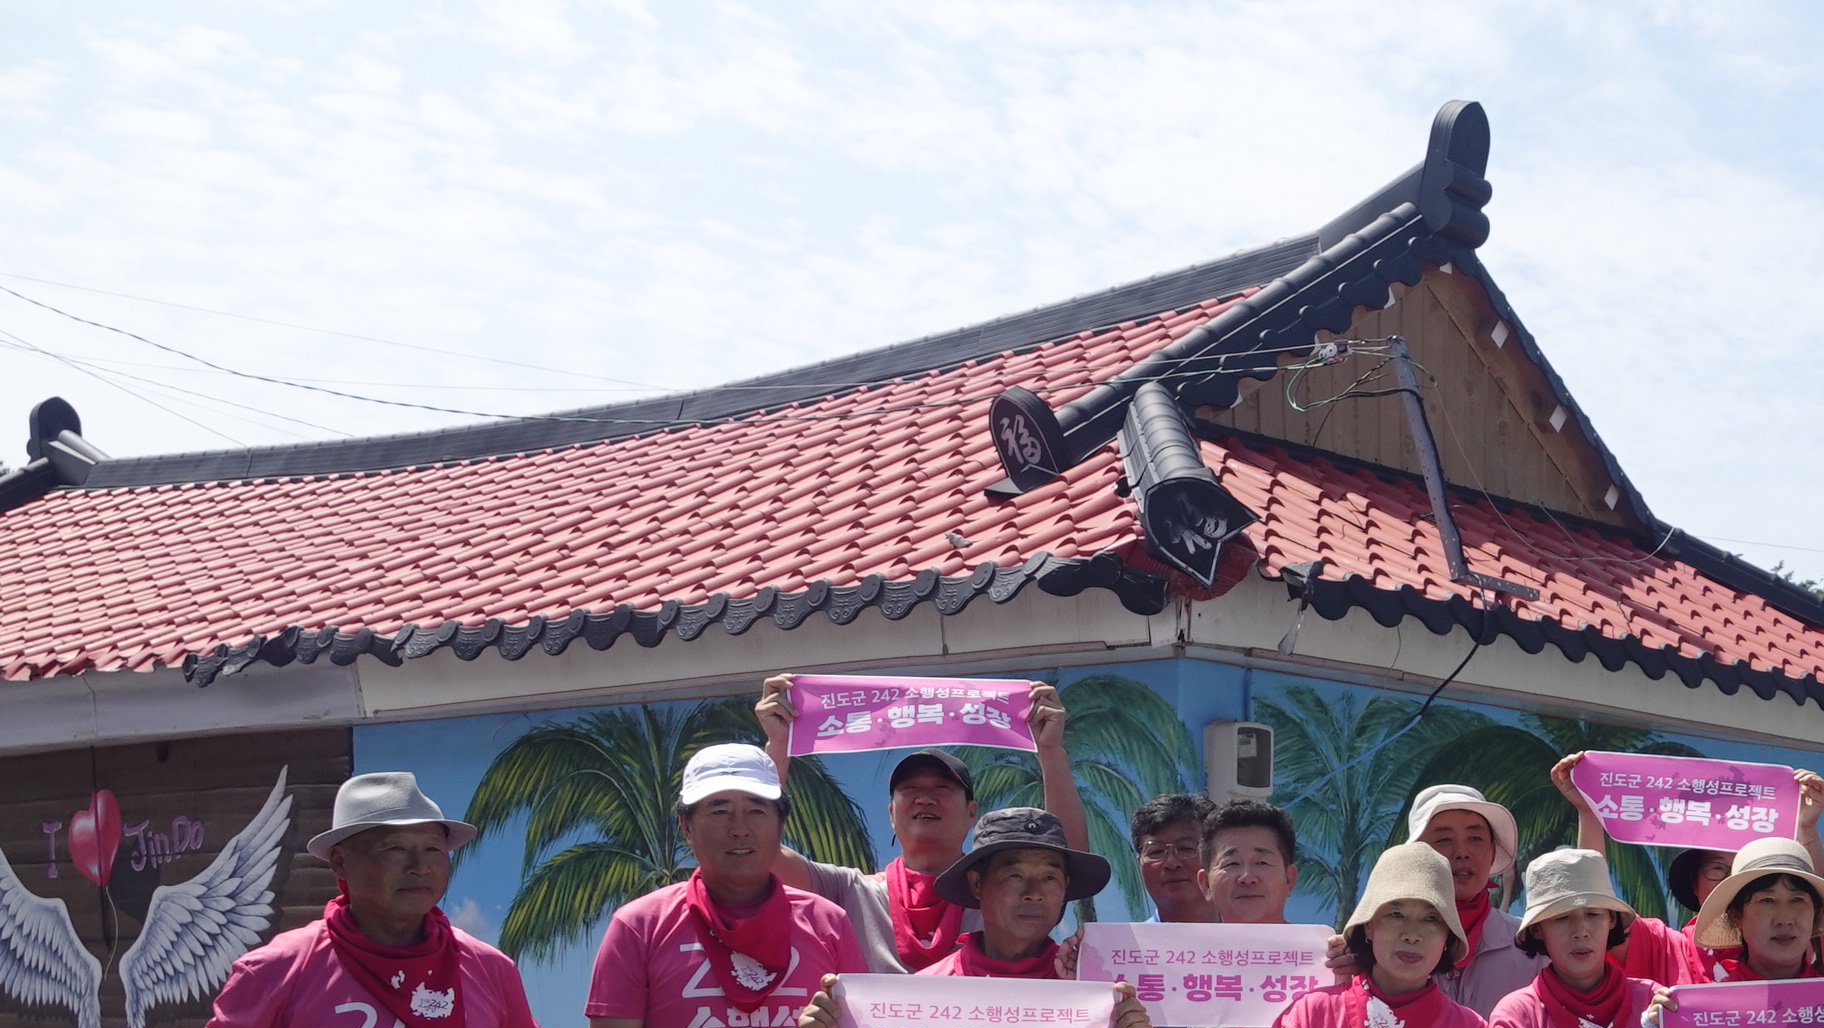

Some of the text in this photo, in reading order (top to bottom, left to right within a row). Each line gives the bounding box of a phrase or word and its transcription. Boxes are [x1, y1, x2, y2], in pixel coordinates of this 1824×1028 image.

[1000, 414, 1041, 464] 福
[820, 686, 1010, 710] 진도군 242 소행성프로젝트
[1600, 772, 1776, 801] 진도군 242 소행성프로젝트
[42, 821, 63, 878] I
[680, 942, 808, 998] 22
[1111, 949, 1315, 967] 진도군 242 소행성프로젝트
[1114, 973, 1319, 1003] 통·행복·성장
[870, 1002, 1091, 1024] 진도군 242 소행성프로젝트
[1692, 1010, 1741, 1027] 진도군
[1746, 1009, 1777, 1025] 242
